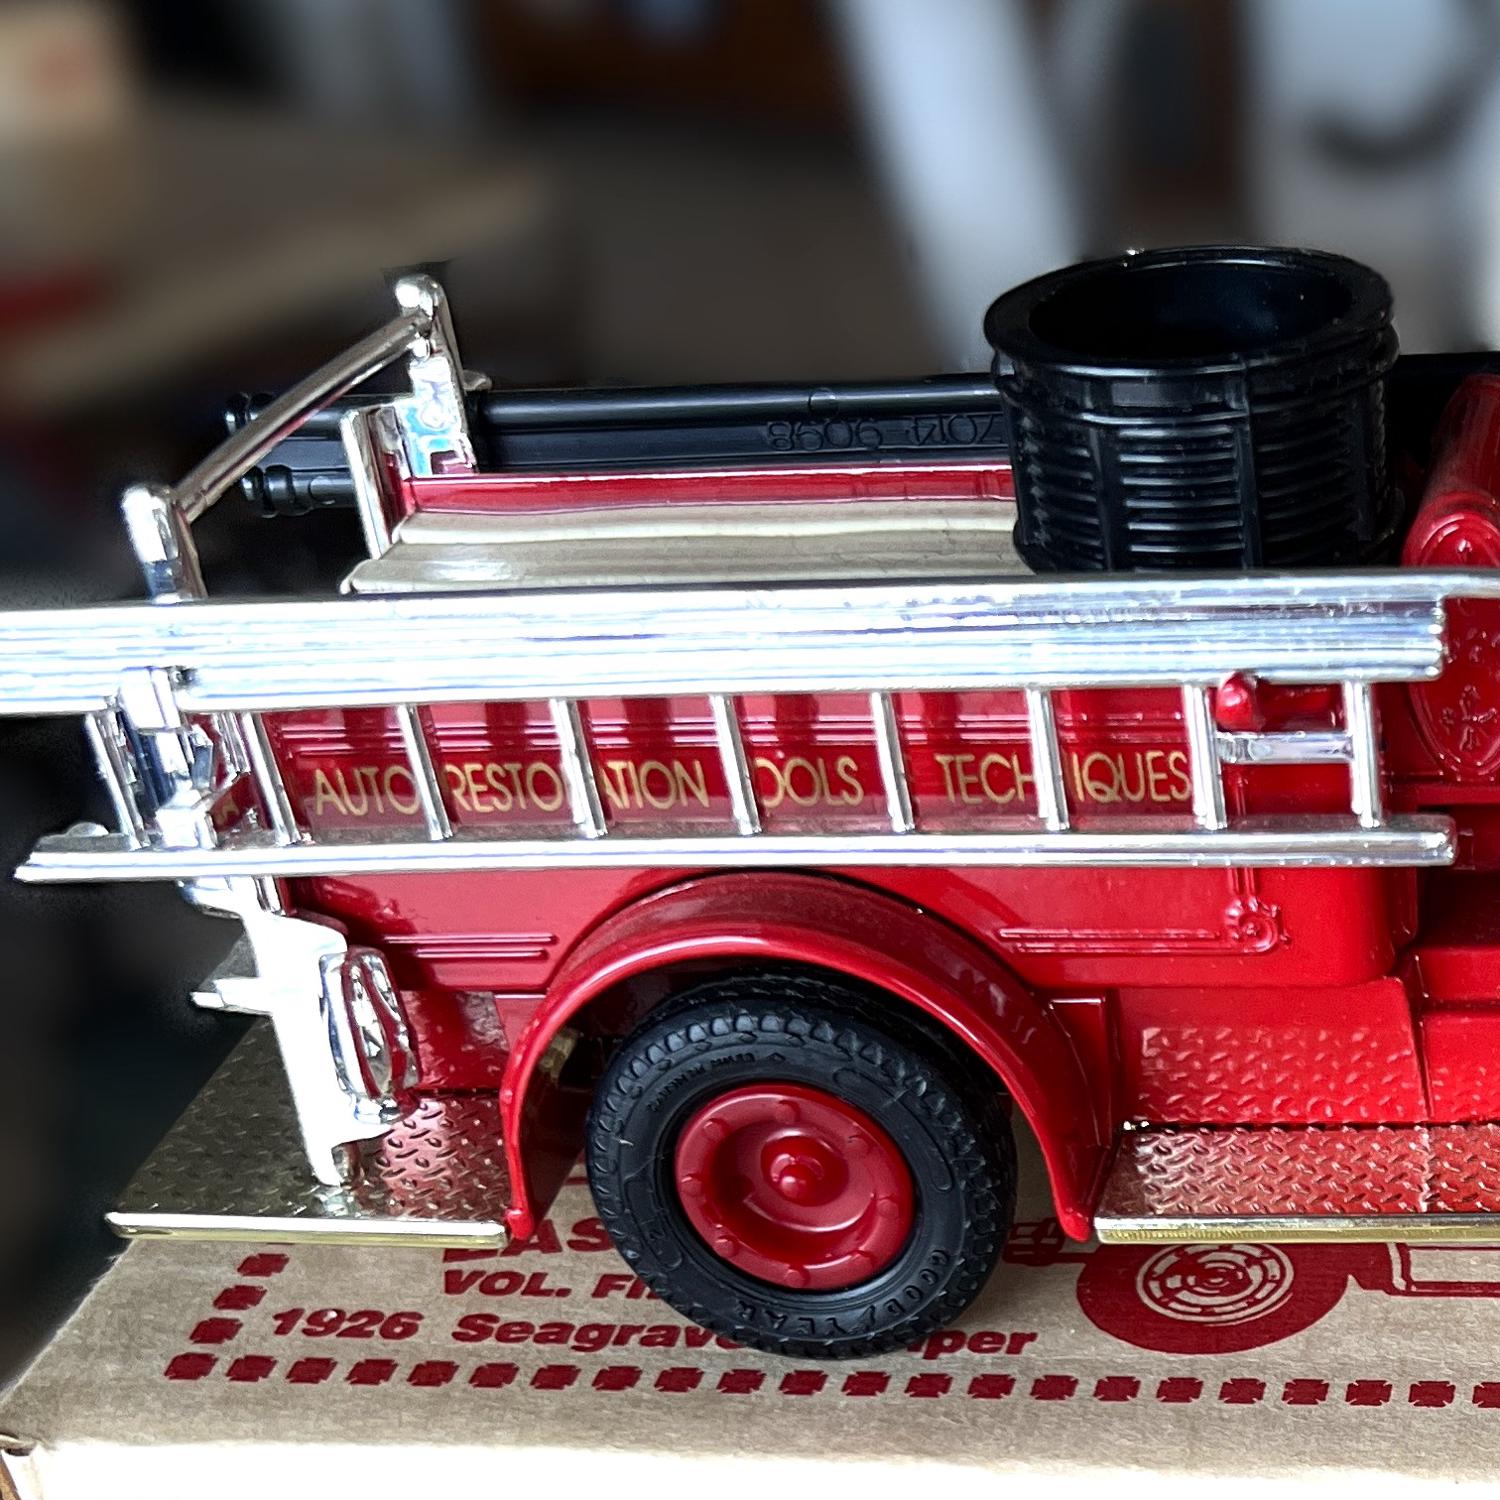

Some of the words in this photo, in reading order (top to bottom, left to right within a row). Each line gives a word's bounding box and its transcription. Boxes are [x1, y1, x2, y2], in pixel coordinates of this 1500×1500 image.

[314, 764, 415, 816] AUTO
[443, 759, 710, 813] RESTOATION
[753, 755, 866, 808] OOLS
[935, 750, 1193, 804] TECHIQUES
[443, 1270, 573, 1298] VOL.
[277, 1310, 419, 1339] 1926
